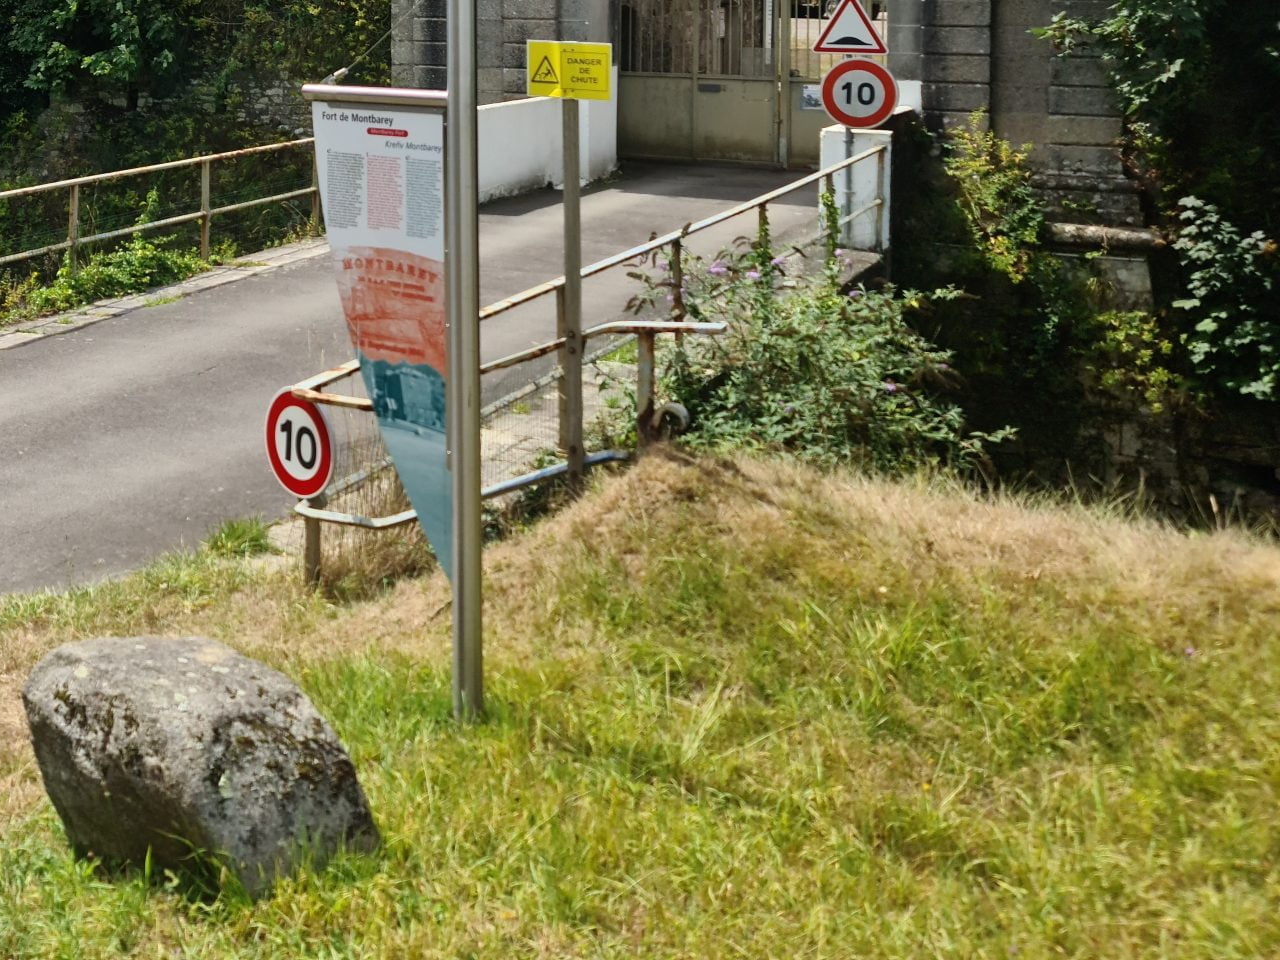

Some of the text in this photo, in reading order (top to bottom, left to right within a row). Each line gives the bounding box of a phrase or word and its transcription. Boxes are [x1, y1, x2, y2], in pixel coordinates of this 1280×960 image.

[841, 81, 875, 105] 10
[322, 111, 394, 127] Fort de Montbarey
[405, 142, 442, 153] Montbarey
[343, 258, 437, 283] MONTBAREY
[280, 418, 317, 470] 10
